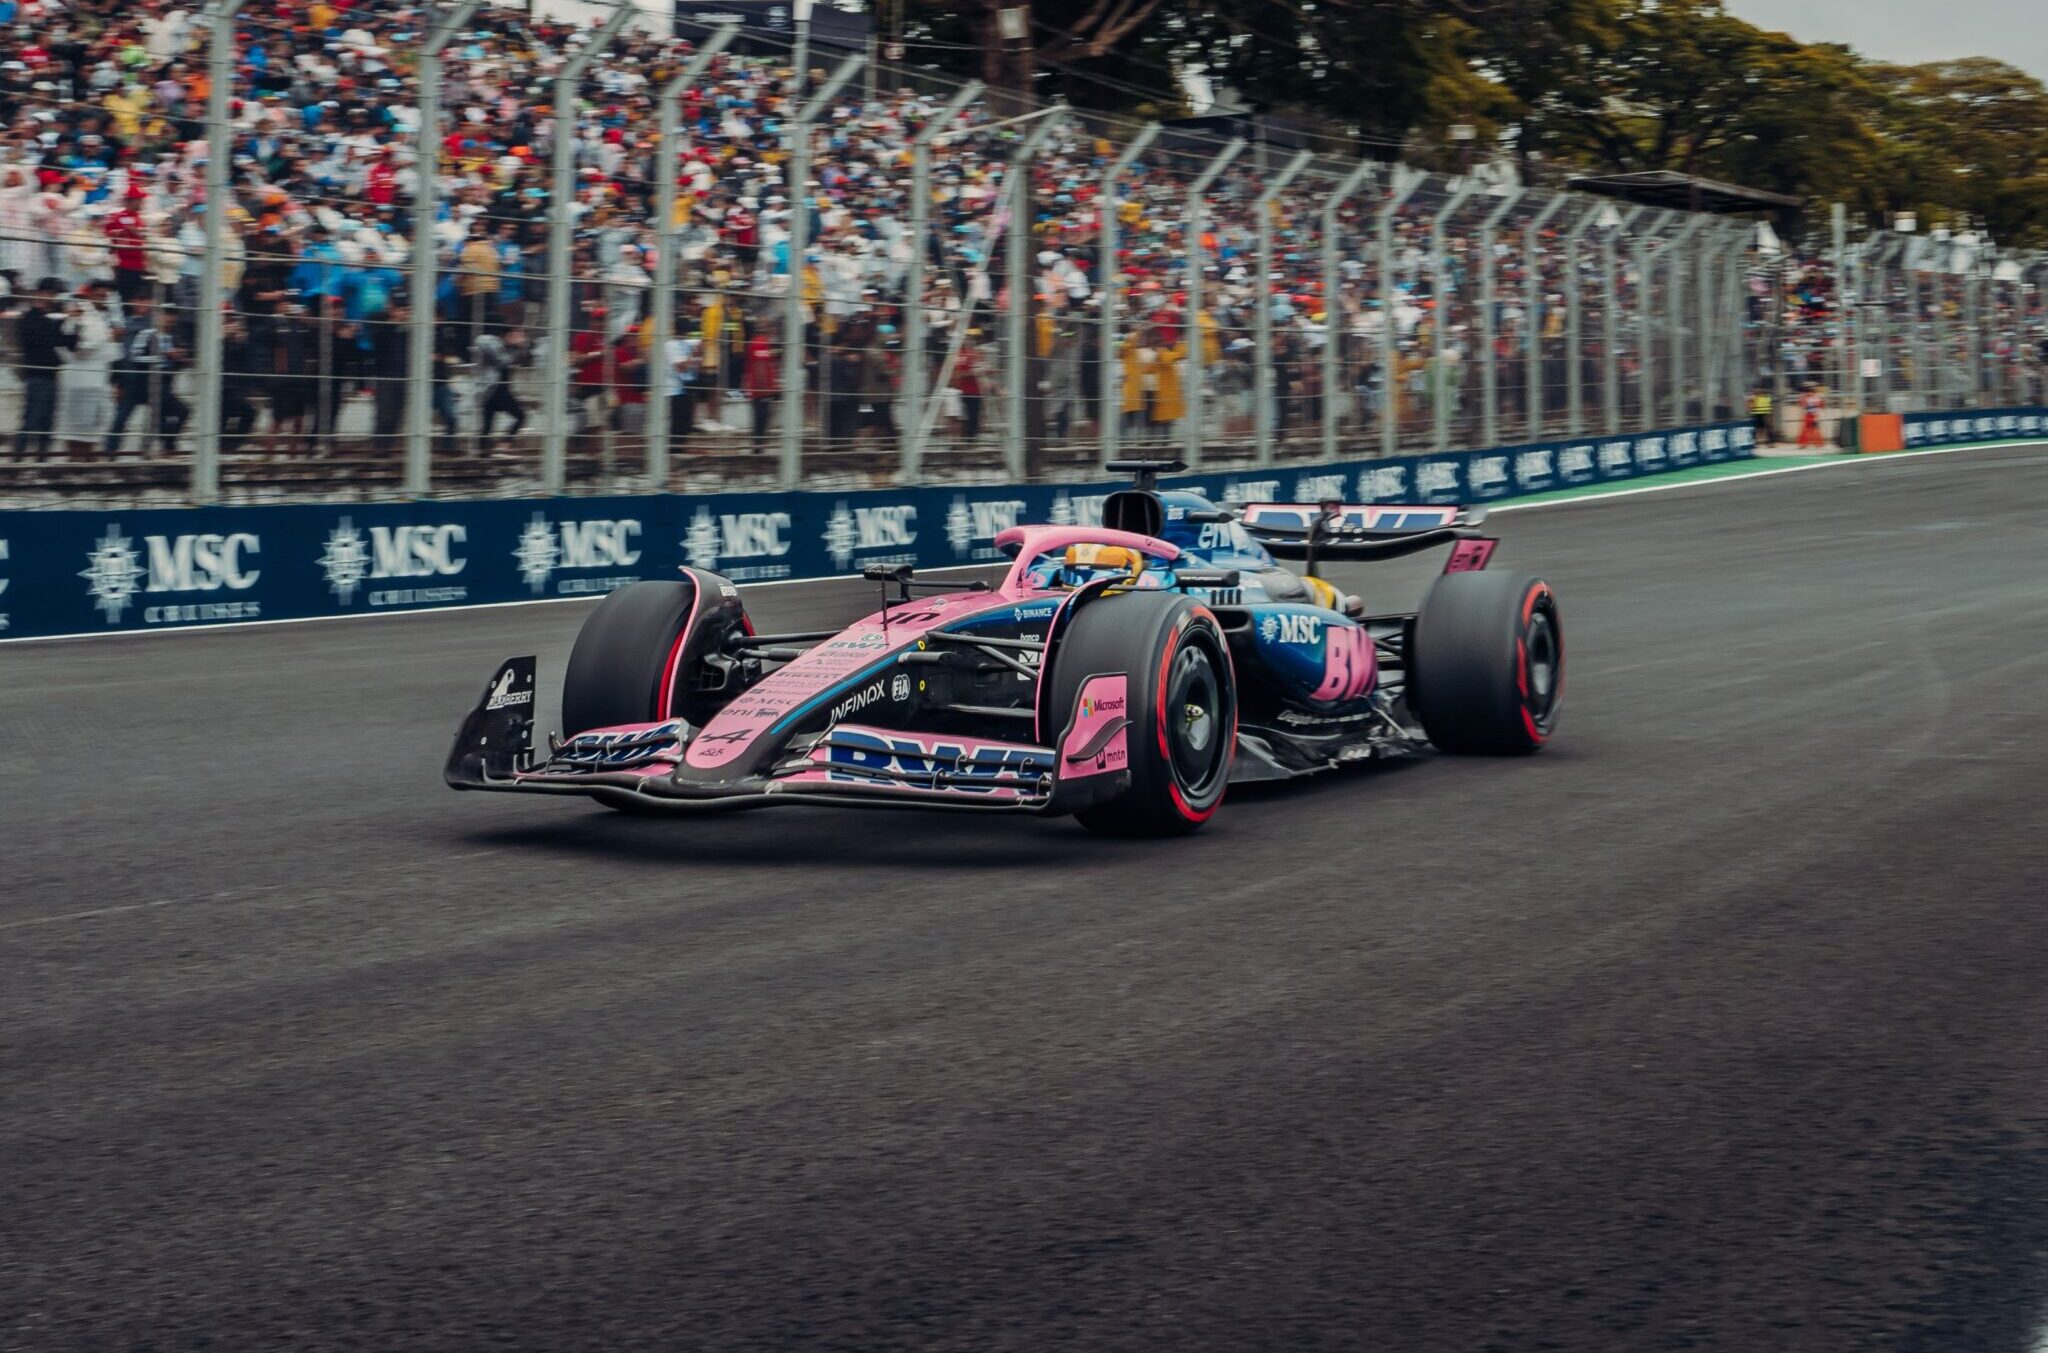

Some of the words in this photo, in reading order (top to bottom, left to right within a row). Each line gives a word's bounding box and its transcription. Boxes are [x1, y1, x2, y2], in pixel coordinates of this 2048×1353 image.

[560, 520, 642, 568] MSC
[720, 513, 791, 557] MSC
[855, 506, 917, 547] MSC
[144, 533, 261, 593] MSC
[369, 524, 467, 577] MSC
[1022, 607, 1053, 619] BINANCE
[1277, 614, 1321, 645] MSC
[830, 679, 886, 725] INFINOX
[1093, 696, 1125, 712] Microsoft
[1106, 749, 1126, 763] mntn
